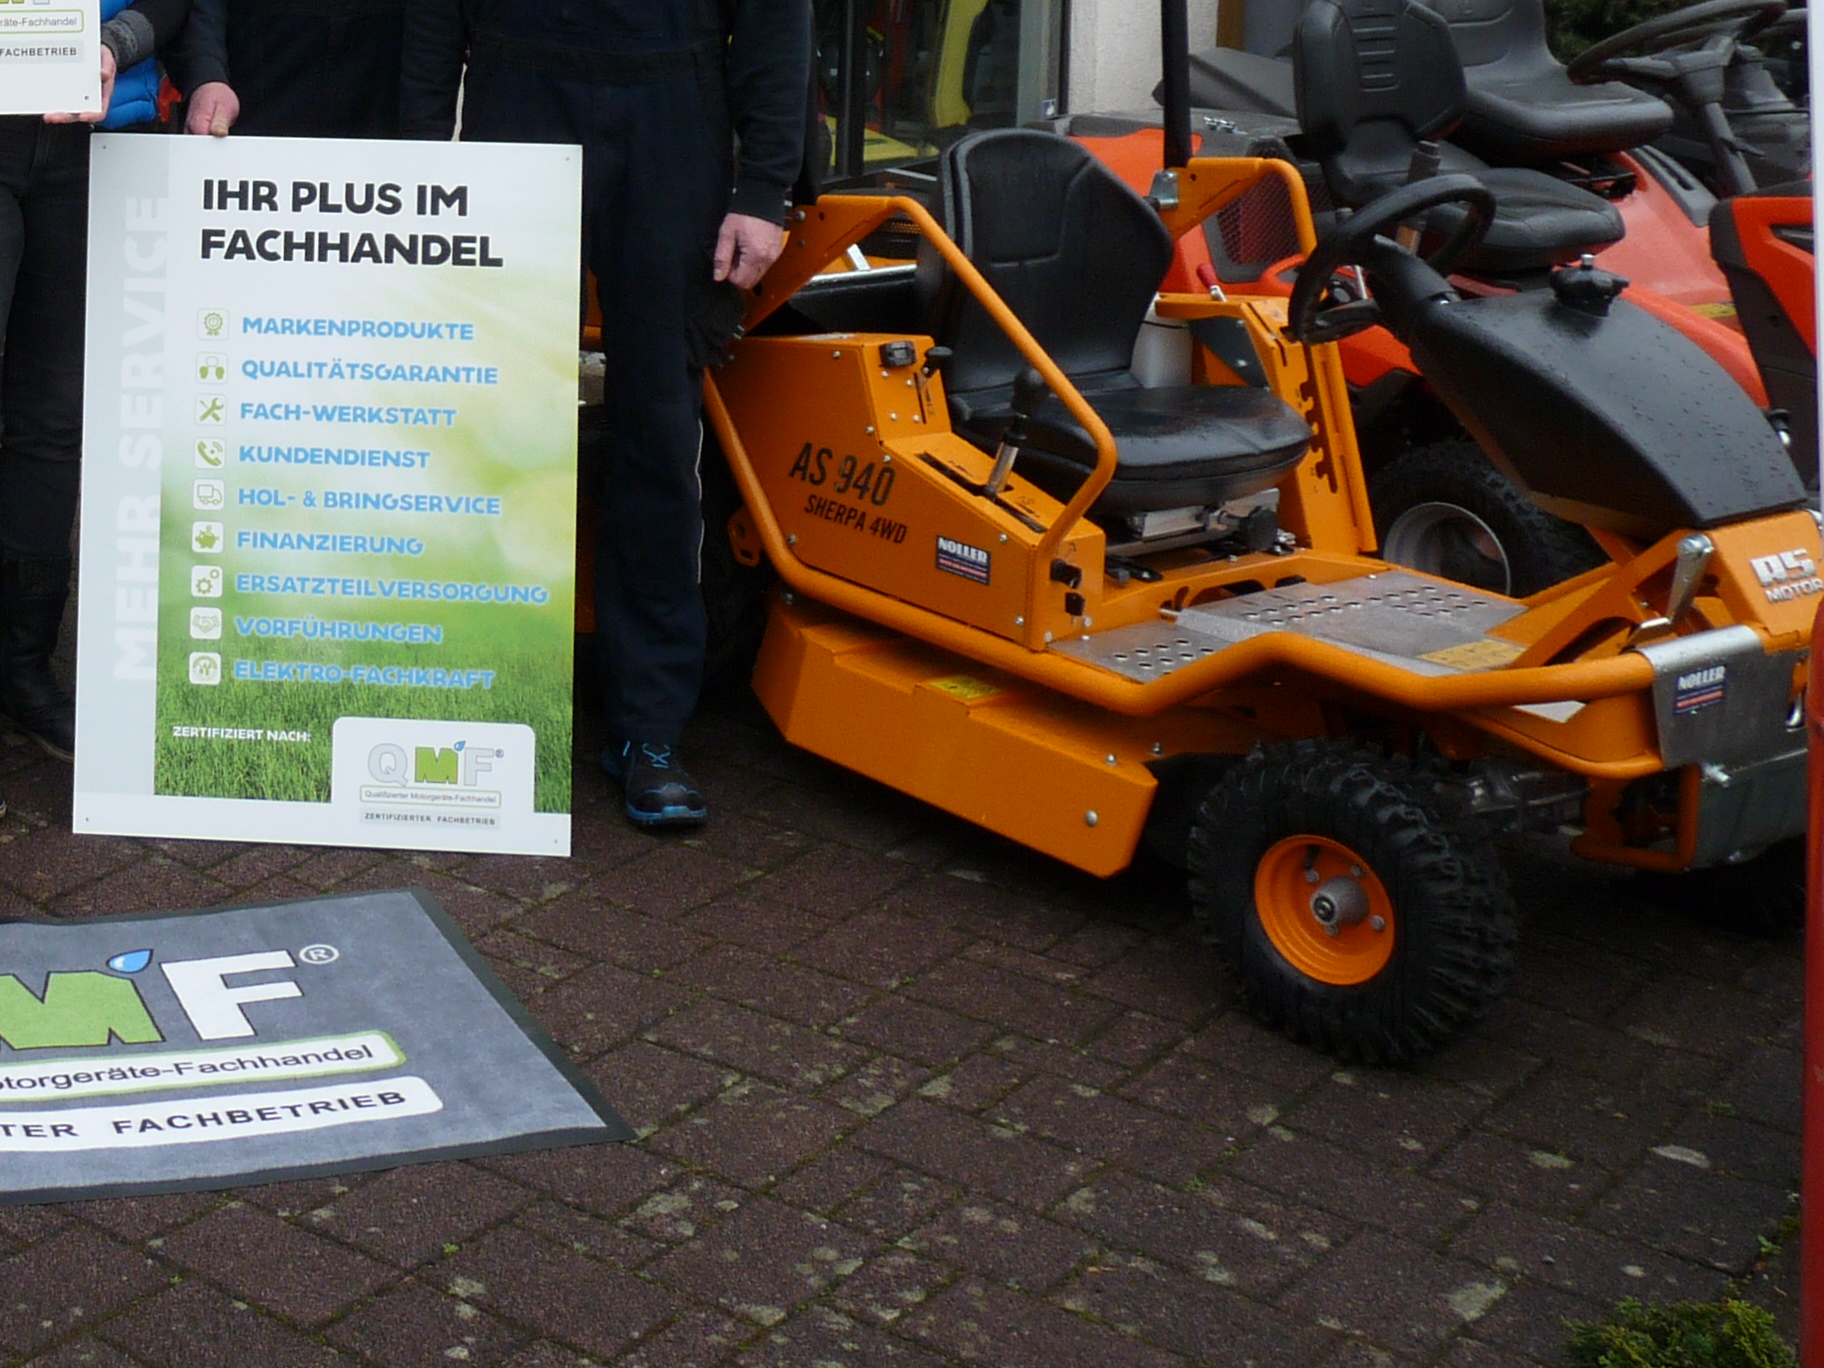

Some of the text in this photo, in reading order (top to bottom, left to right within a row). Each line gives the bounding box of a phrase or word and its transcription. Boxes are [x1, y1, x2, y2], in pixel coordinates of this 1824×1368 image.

[0, 47, 77, 57] FACHBETRIEB
[202, 178, 469, 217] IHR PLUS IM
[200, 228, 505, 268] FACHHANDEL
[241, 316, 474, 341] MARKENPRODUKTE
[241, 357, 499, 385] QUALITÄTSGARANTIE
[240, 402, 458, 426] FACH-WERKSTATT
[113, 195, 169, 682] MEHR SERVICE
[239, 445, 431, 469] KUNDENDIENST
[789, 442, 896, 506] AS 940
[238, 487, 501, 515] HOL- & BRINGSERVICE
[805, 494, 908, 544] SHERPA 4WD
[236, 531, 424, 555] FINANZIERUNG
[938, 537, 988, 564] NOLLER
[1750, 548, 1817, 588] AS
[235, 573, 549, 604] ERSATZTEILVERSORGUNG
[1764, 578, 1824, 603] MOTOR
[234, 615, 443, 644] VORFÜHRUNGEN
[234, 660, 495, 689] ELEKTRO-FACHKRAFT
[1678, 665, 1725, 690] NOLLER
[172, 726, 312, 743] ZERTIFIZIERT NACH:
[364, 813, 496, 826] ZERTIFIZIERTER FACHBETRIEB
[112, 1089, 408, 1137] FACHBETRIEB
